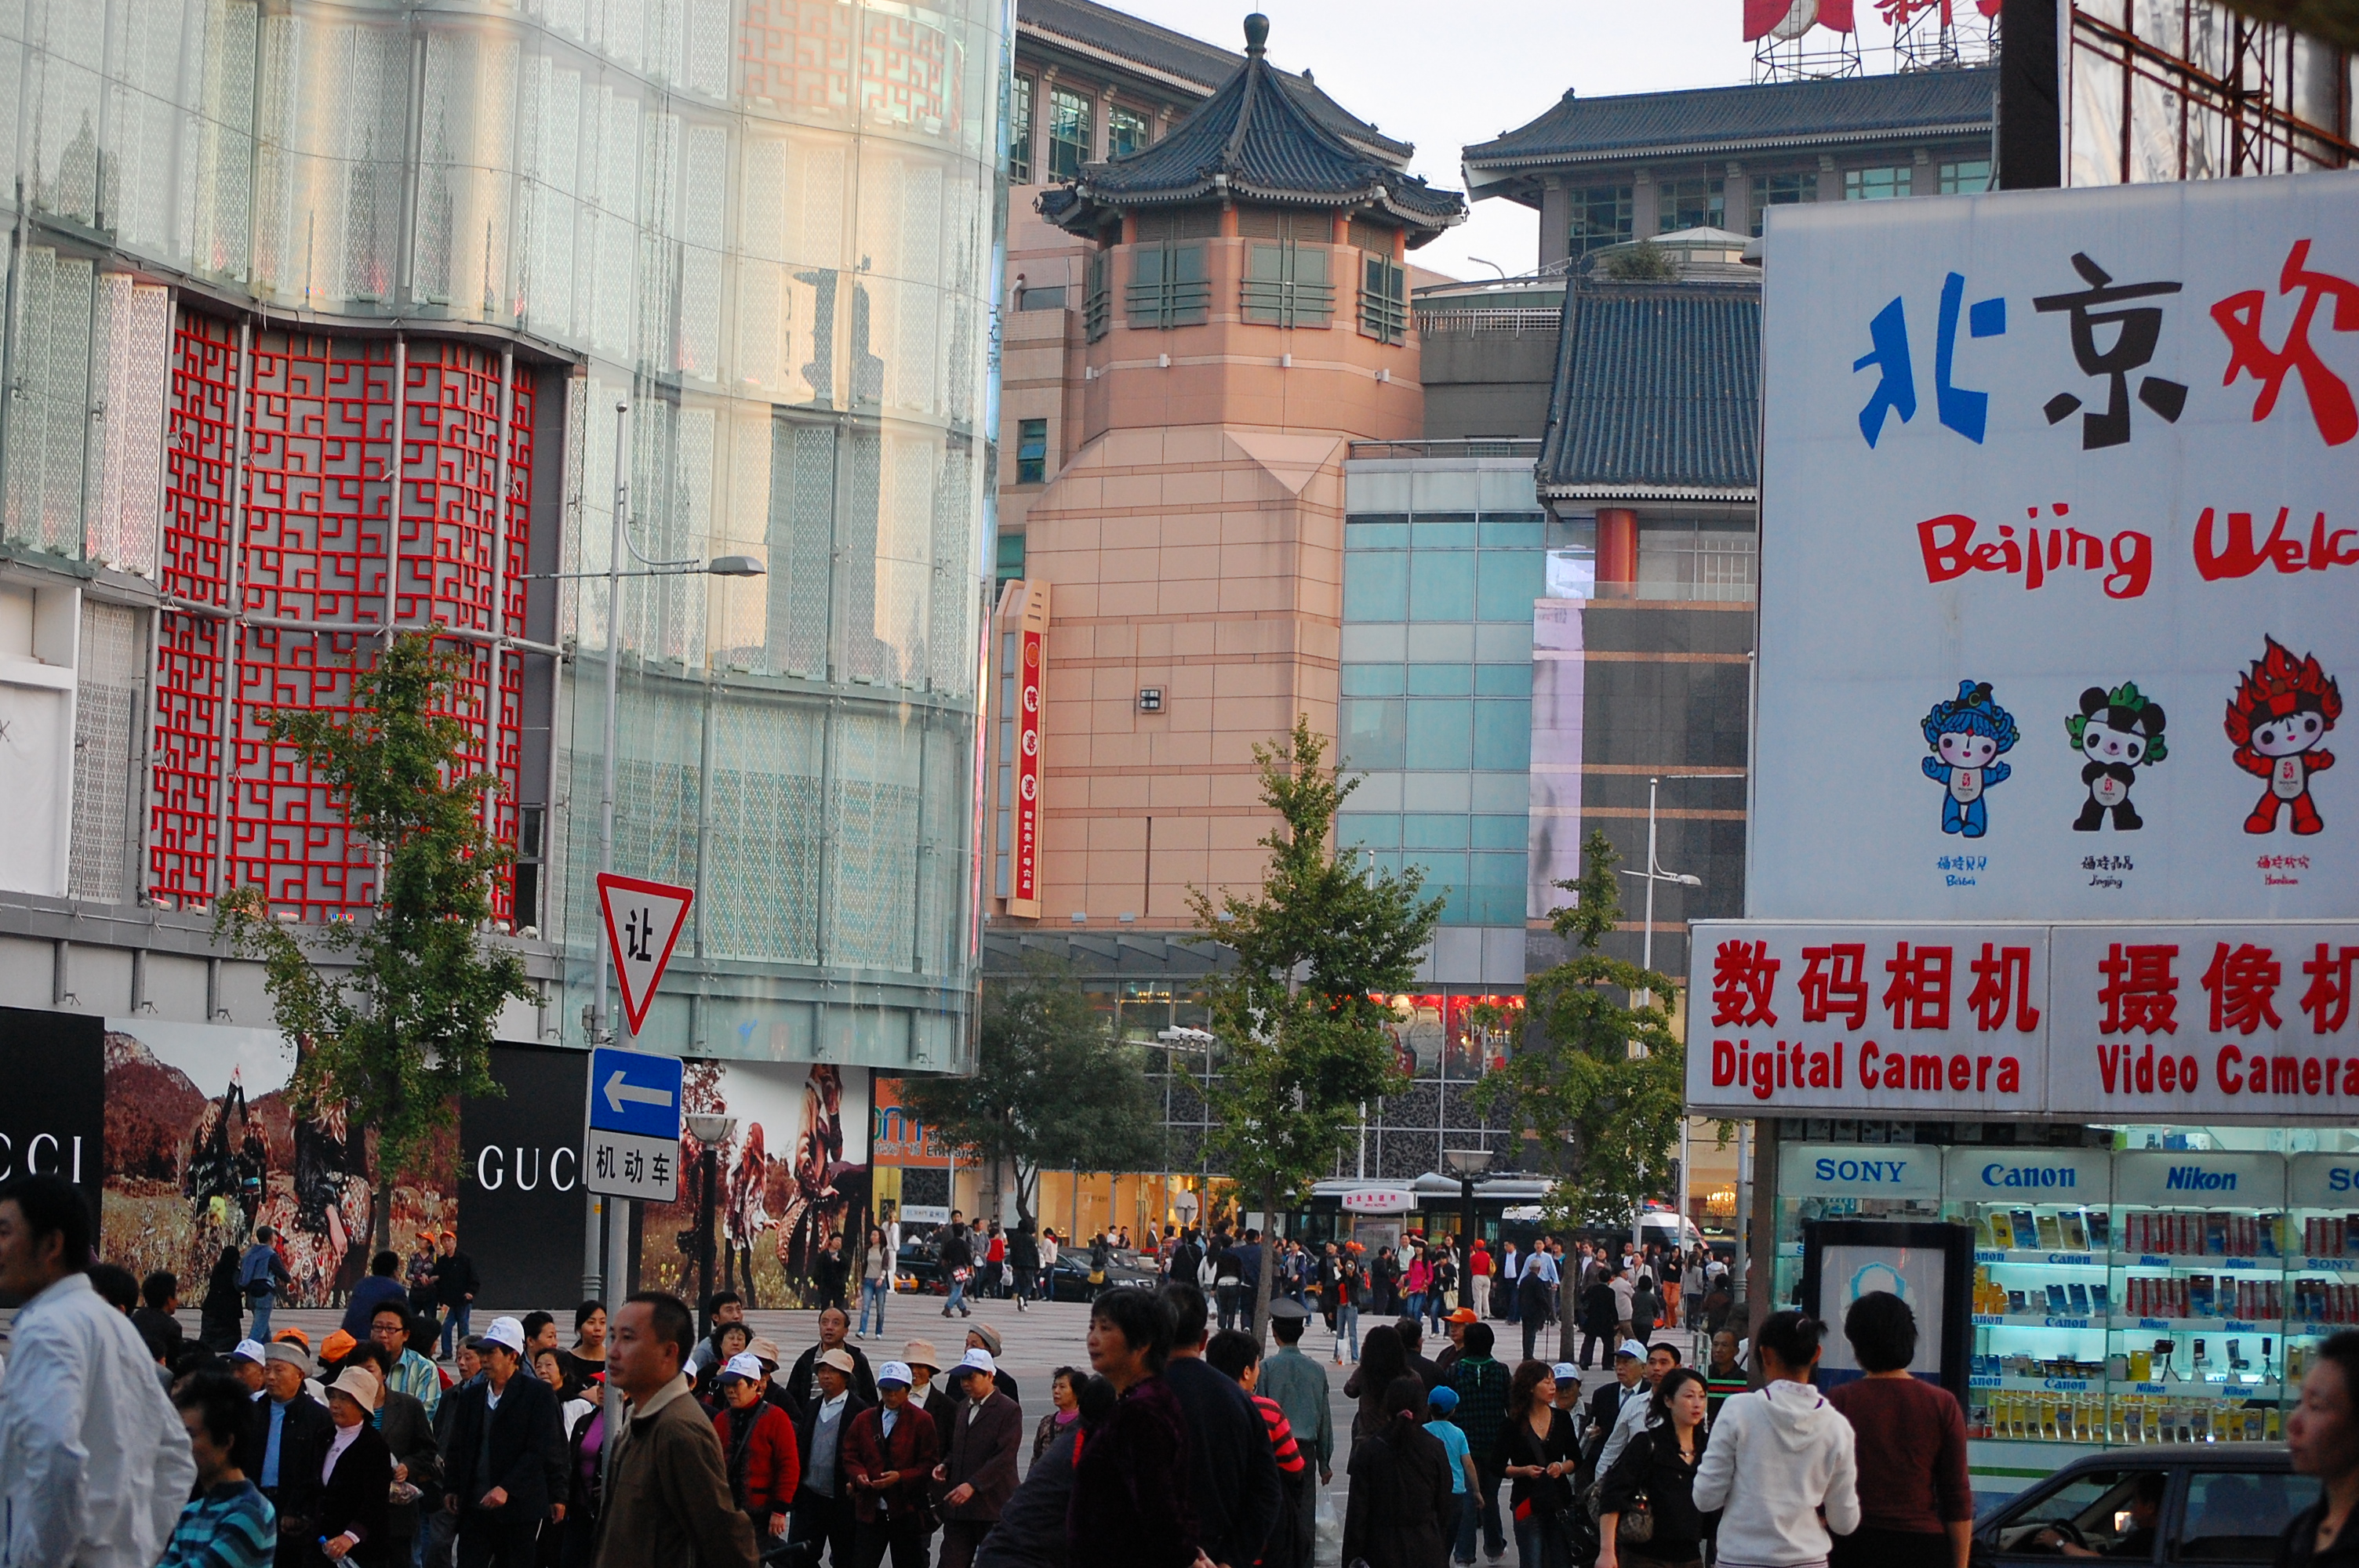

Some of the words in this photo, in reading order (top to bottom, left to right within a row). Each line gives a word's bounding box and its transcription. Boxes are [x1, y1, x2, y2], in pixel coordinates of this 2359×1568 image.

[1917, 503, 2151, 599] Beijing
[1946, 874, 1976, 887] Beibei
[2088, 874, 2122, 888] Jingjing
[626, 908, 652, 962] 让
[1711, 939, 2040, 1033] 数码相机
[2098, 942, 2359, 1035] 摄像机
[1712, 1039, 1843, 1099] Digital
[1859, 1040, 2020, 1093] Camera
[2097, 1044, 2197, 1094] Video
[2216, 1044, 2359, 1095] Camera
[596, 1145, 670, 1186] 机动车
[1816, 1158, 1907, 1182] SONY
[1981, 1163, 2076, 1188] Canon
[2166, 1167, 2237, 1190] Nikon
[1974, 1252, 2005, 1262] anon
[2048, 1254, 2091, 1265] Canon
[2139, 1255, 2170, 1267] Nikon
[2225, 1258, 2255, 1269] Nikon
[2307, 1258, 2356, 1269] SONY
[1972, 1316, 2003, 1325] anon
[2045, 1317, 2088, 1328] Canon
[2139, 1318, 2169, 1329] Nikon
[2224, 1321, 2255, 1332] Nikon
[1969, 1377, 2002, 1387] anon
[2044, 1378, 2087, 1390] Canon
[2135, 1383, 2166, 1394] Nikon
[2223, 1386, 2253, 1396] Nikon
